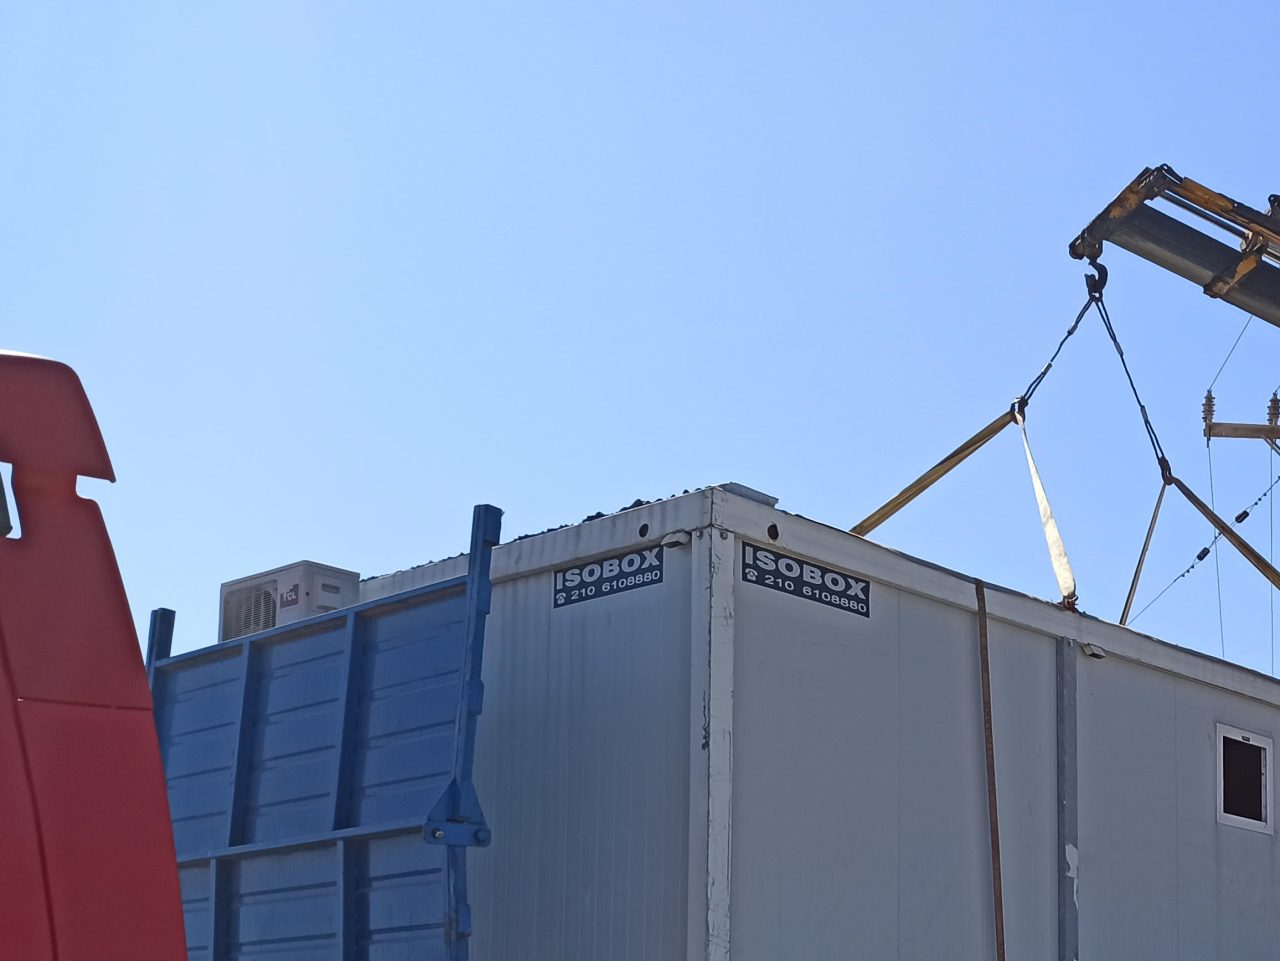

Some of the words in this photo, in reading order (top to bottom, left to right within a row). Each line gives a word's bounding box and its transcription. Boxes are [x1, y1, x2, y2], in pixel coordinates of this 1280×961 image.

[556, 548, 660, 590] ISOBOX
[571, 586, 596, 600] 210
[601, 570, 661, 593] 6108880
[744, 545, 867, 600] ISOBOX
[764, 574, 795, 591] 210
[802, 586, 868, 613] 6108880
